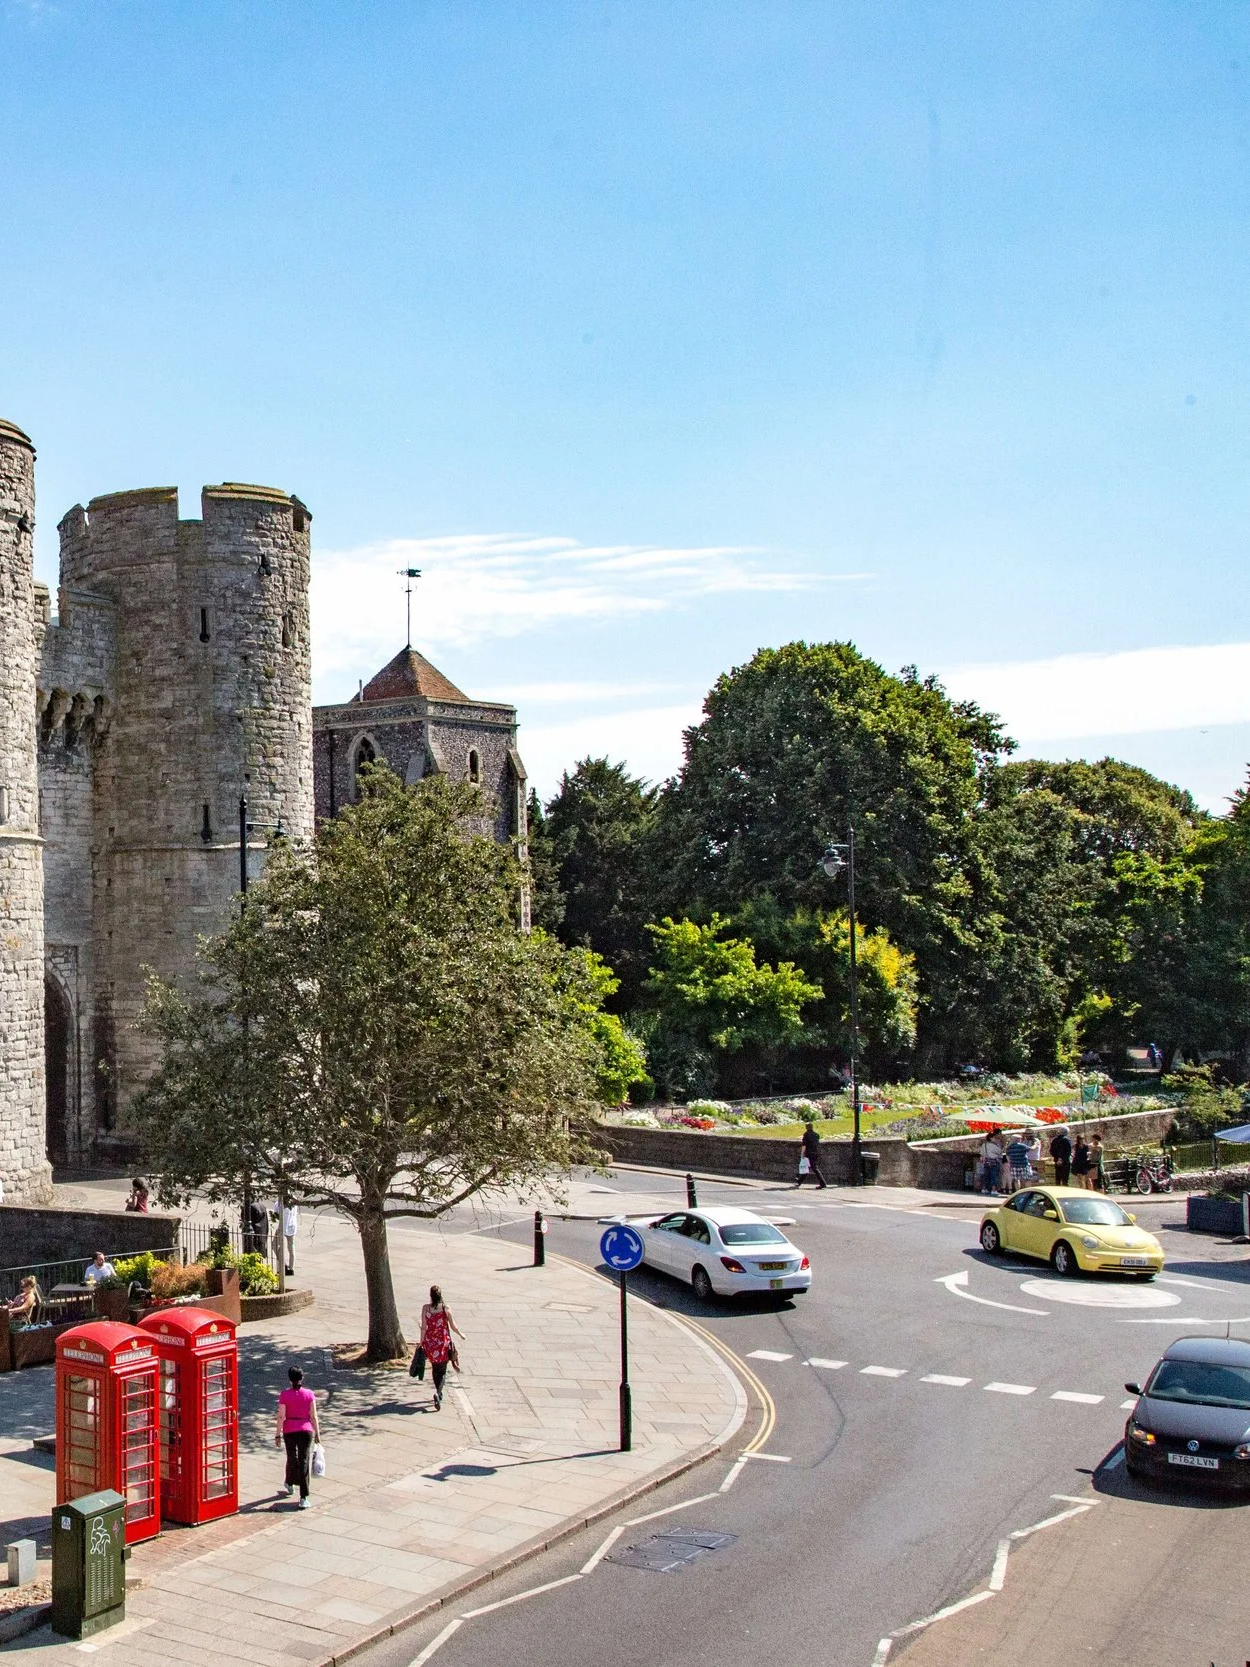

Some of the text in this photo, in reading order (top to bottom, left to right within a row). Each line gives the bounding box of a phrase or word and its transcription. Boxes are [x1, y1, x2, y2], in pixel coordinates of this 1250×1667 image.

[198, 1333, 229, 1345] TELEPHONE
[66, 1348, 103, 1363] TELEPHONE
[117, 1348, 151, 1363] TELEPHONE
[1172, 1454, 1215, 1467] FT62 LVN
